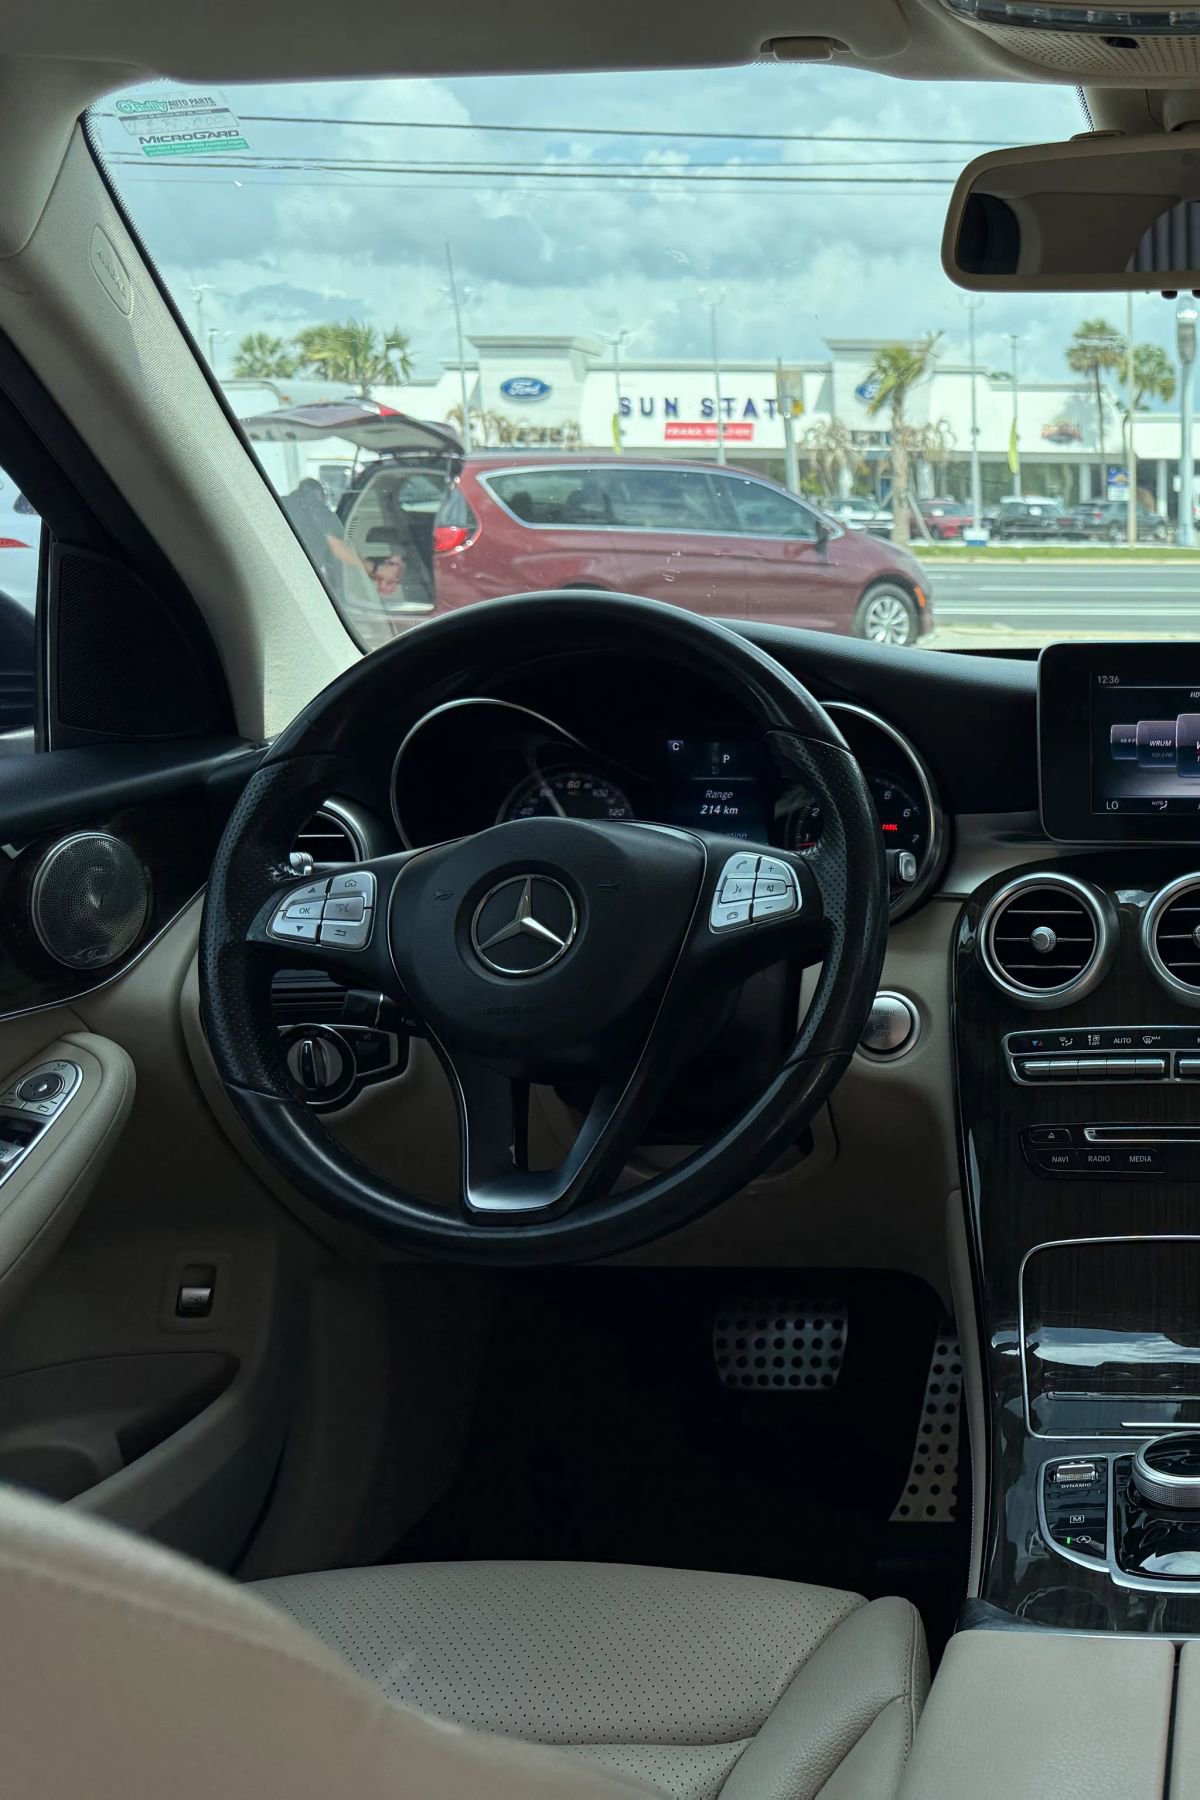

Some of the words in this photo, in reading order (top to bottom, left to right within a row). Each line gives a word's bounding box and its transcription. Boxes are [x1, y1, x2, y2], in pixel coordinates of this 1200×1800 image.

[168, 98, 188, 107] AUTO
[189, 97, 216, 106] PARTS
[620, 396, 678, 418] SUN
[701, 396, 796, 419] STAT
[1097, 675, 1120, 685] 12:36
[1149, 739, 1172, 747] WRUM
[723, 754, 731, 764] P
[705, 789, 734, 801] Range
[700, 804, 721, 815] 214
[723, 804, 739, 815] km
[1105, 801, 1119, 810] LO
[903, 808, 911, 817] 6
[299, 907, 311, 915] OK
[1113, 1037, 1132, 1045] AUTO
[1087, 1155, 1111, 1163] RADIO
[1129, 1155, 1152, 1163] MEDIA
